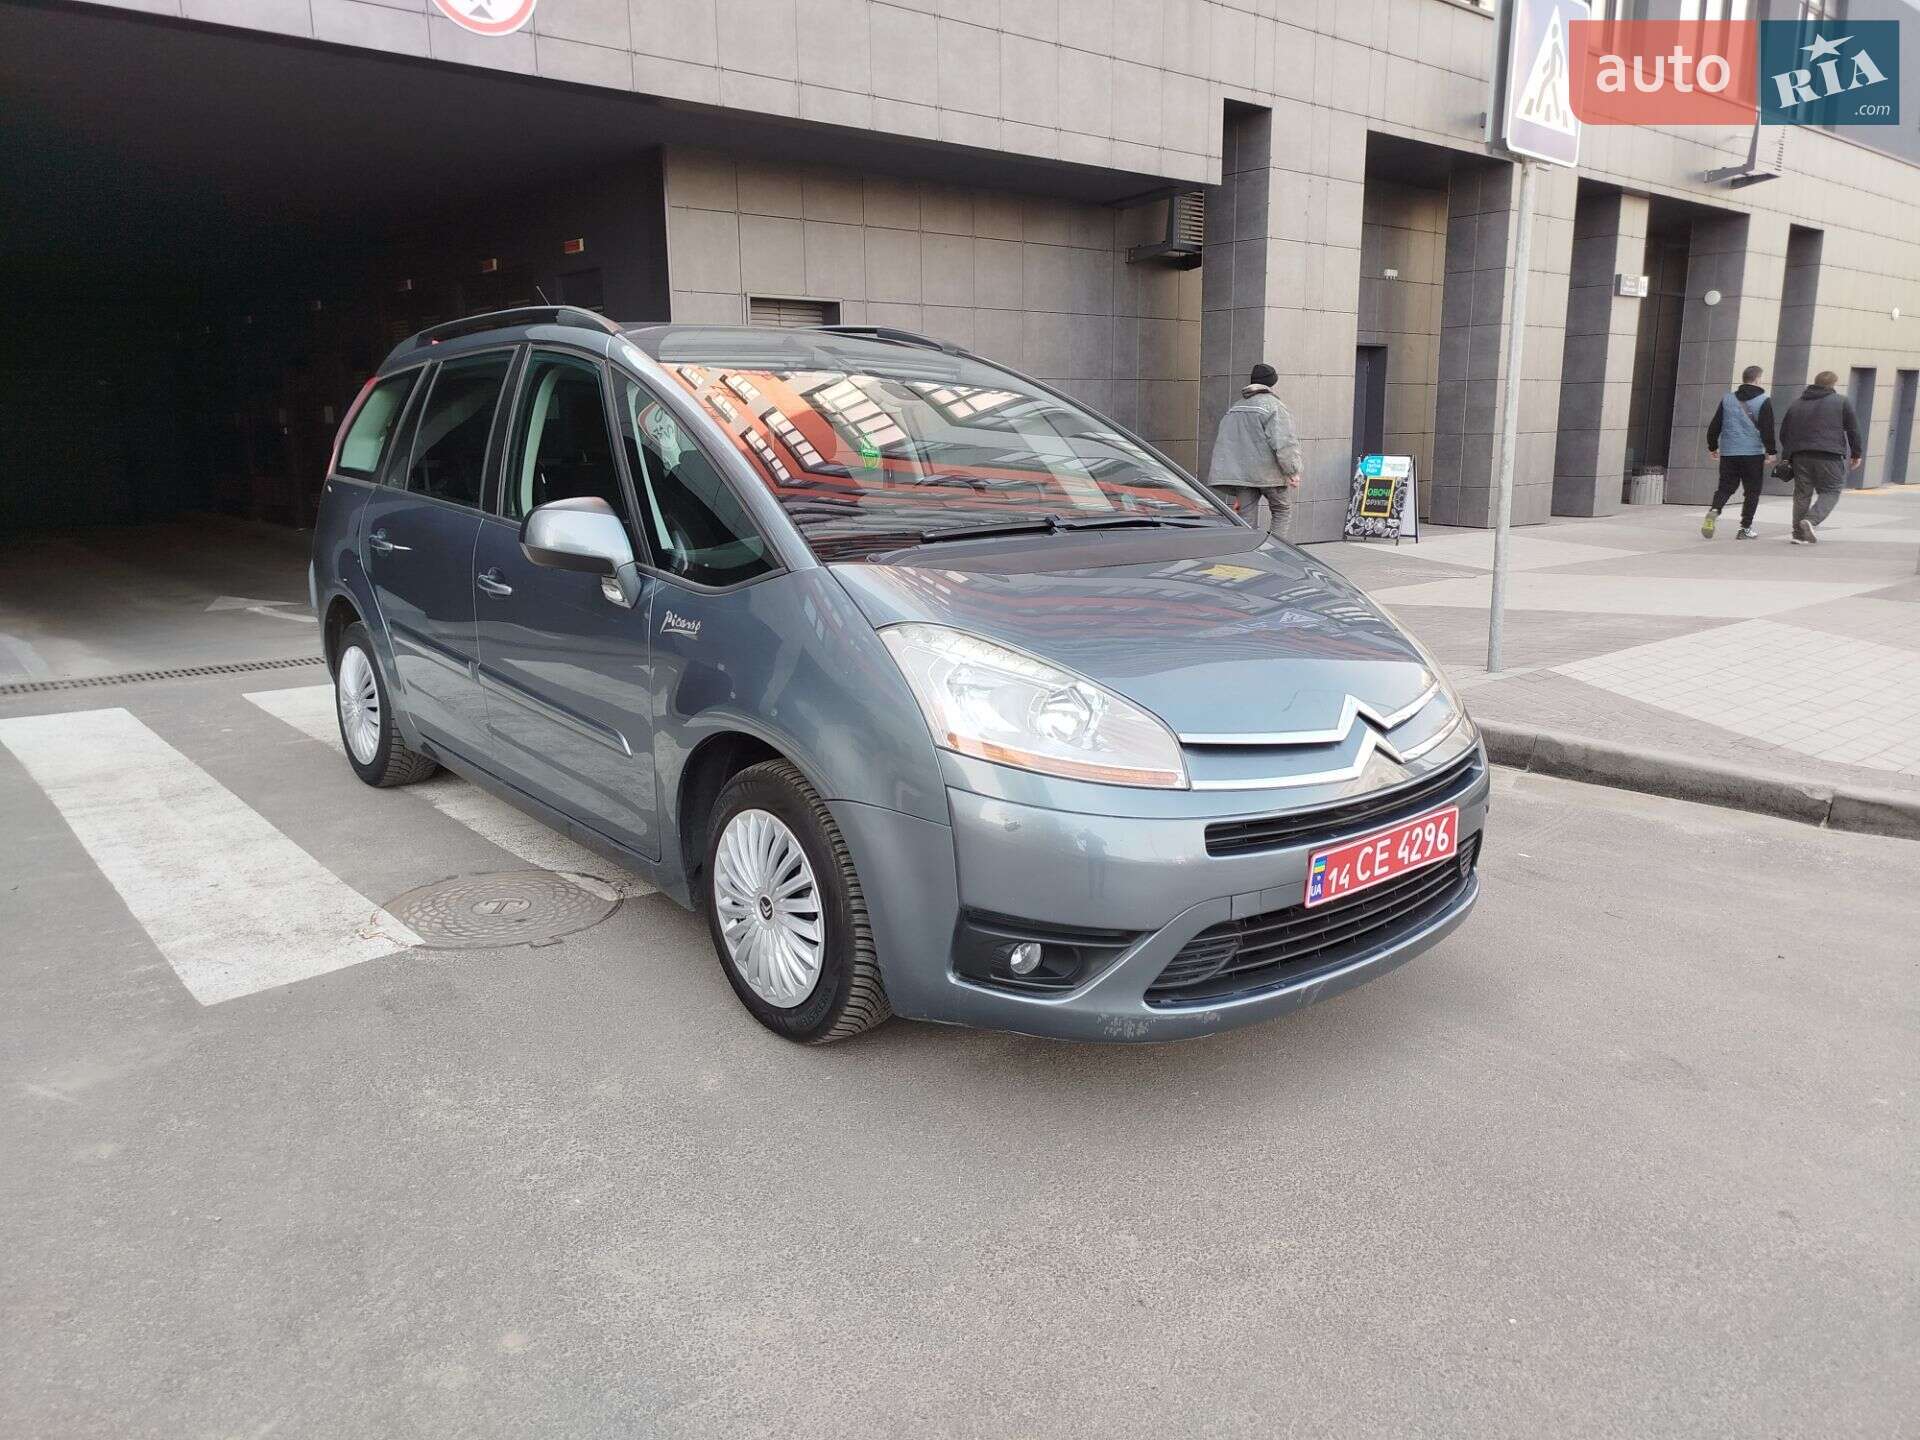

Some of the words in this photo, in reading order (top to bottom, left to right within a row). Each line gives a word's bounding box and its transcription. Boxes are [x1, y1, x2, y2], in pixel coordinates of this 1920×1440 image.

[1328, 863, 1351, 893] 14
[1356, 838, 1392, 881] CE
[1397, 816, 1450, 865] 4296
[1310, 884, 1322, 897] UA
